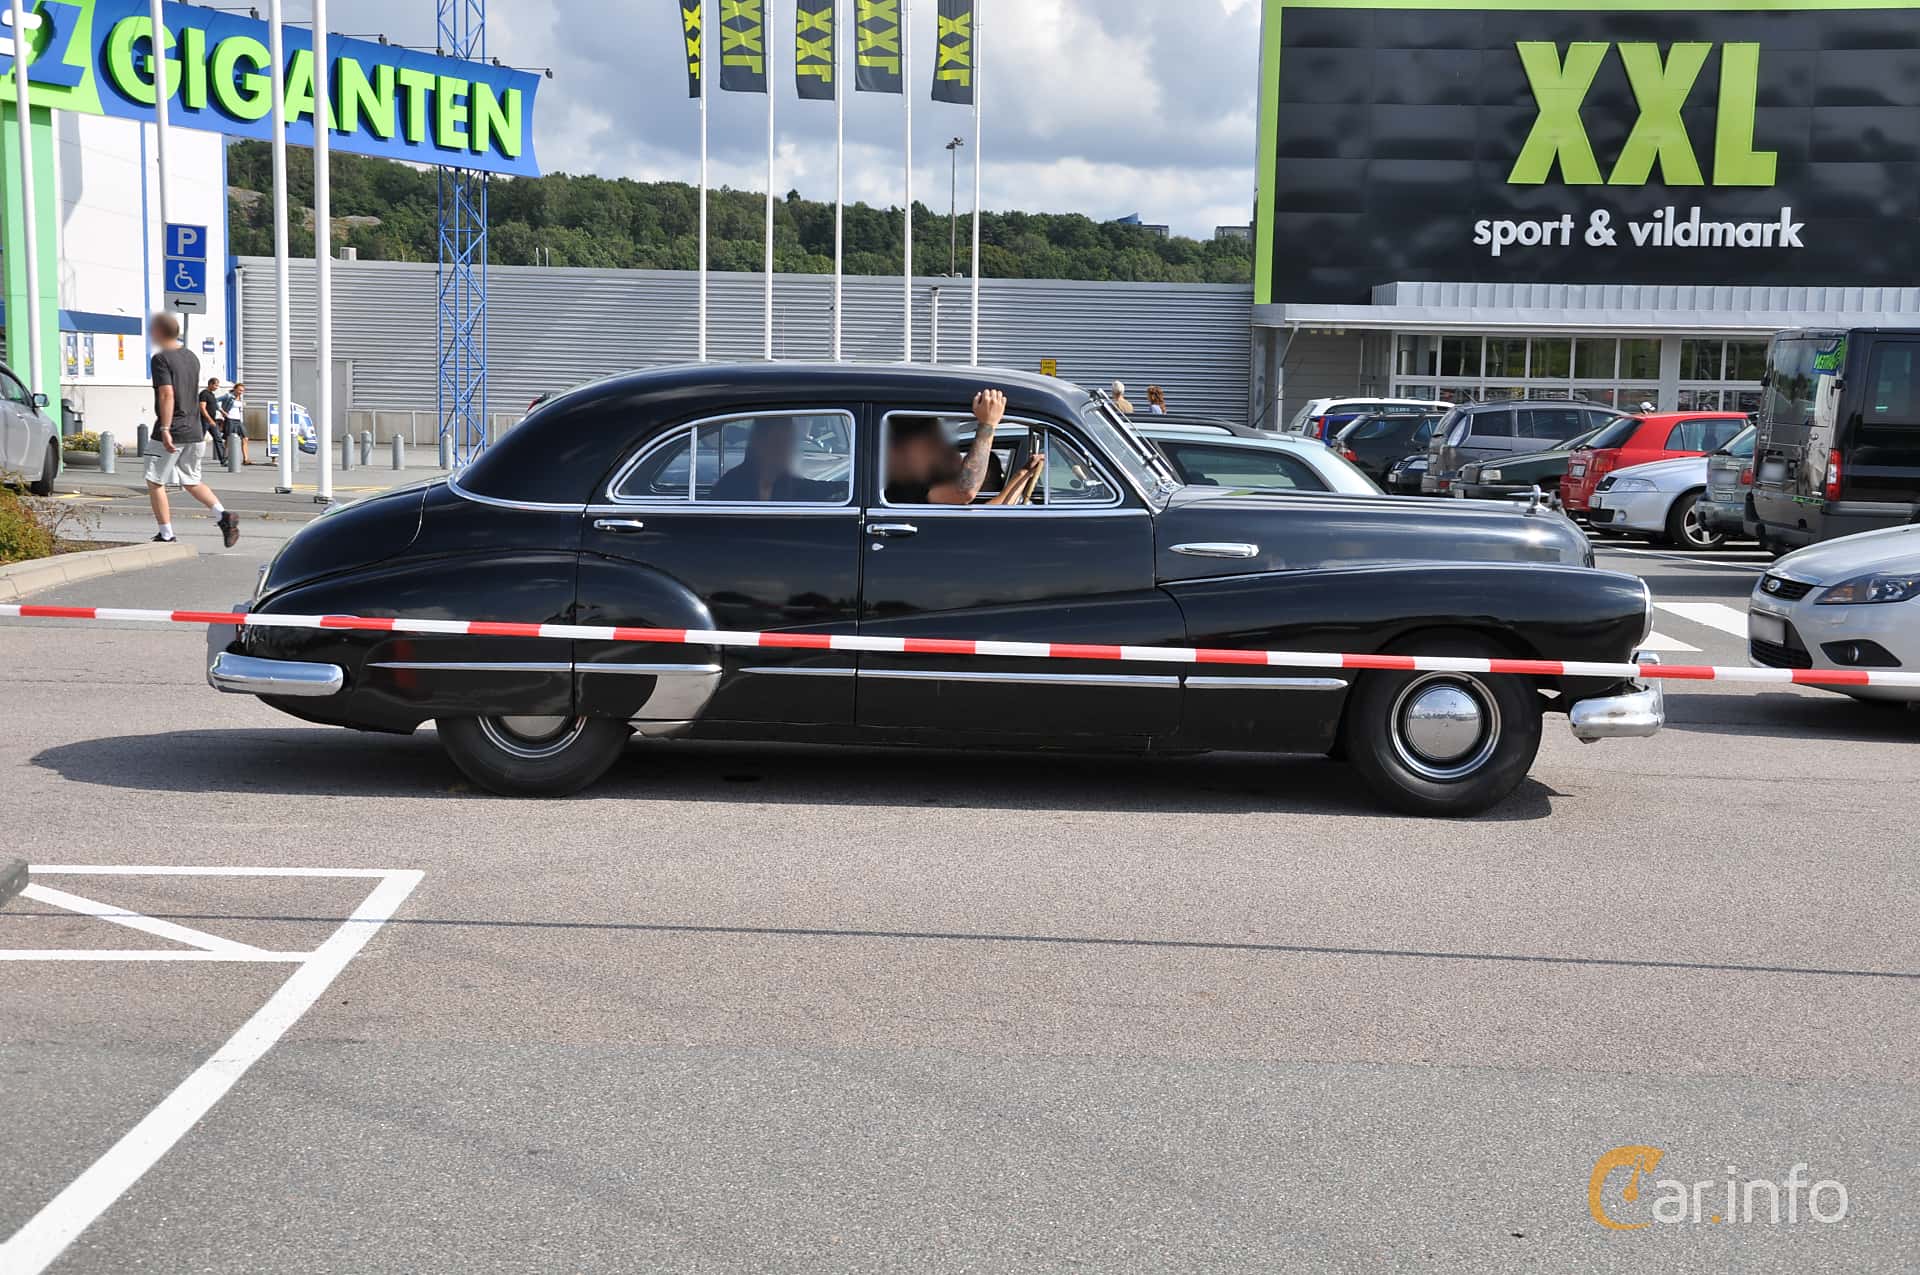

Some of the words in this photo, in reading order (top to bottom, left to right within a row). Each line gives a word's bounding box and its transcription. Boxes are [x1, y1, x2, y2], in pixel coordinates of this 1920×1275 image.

[107, 16, 522, 157] GIGANTEN
[1506, 41, 1777, 186] XXL
[177, 228, 198, 254] P
[1473, 214, 1575, 256] sport
[1584, 209, 1617, 246] &
[1628, 206, 1805, 247] vildmark
